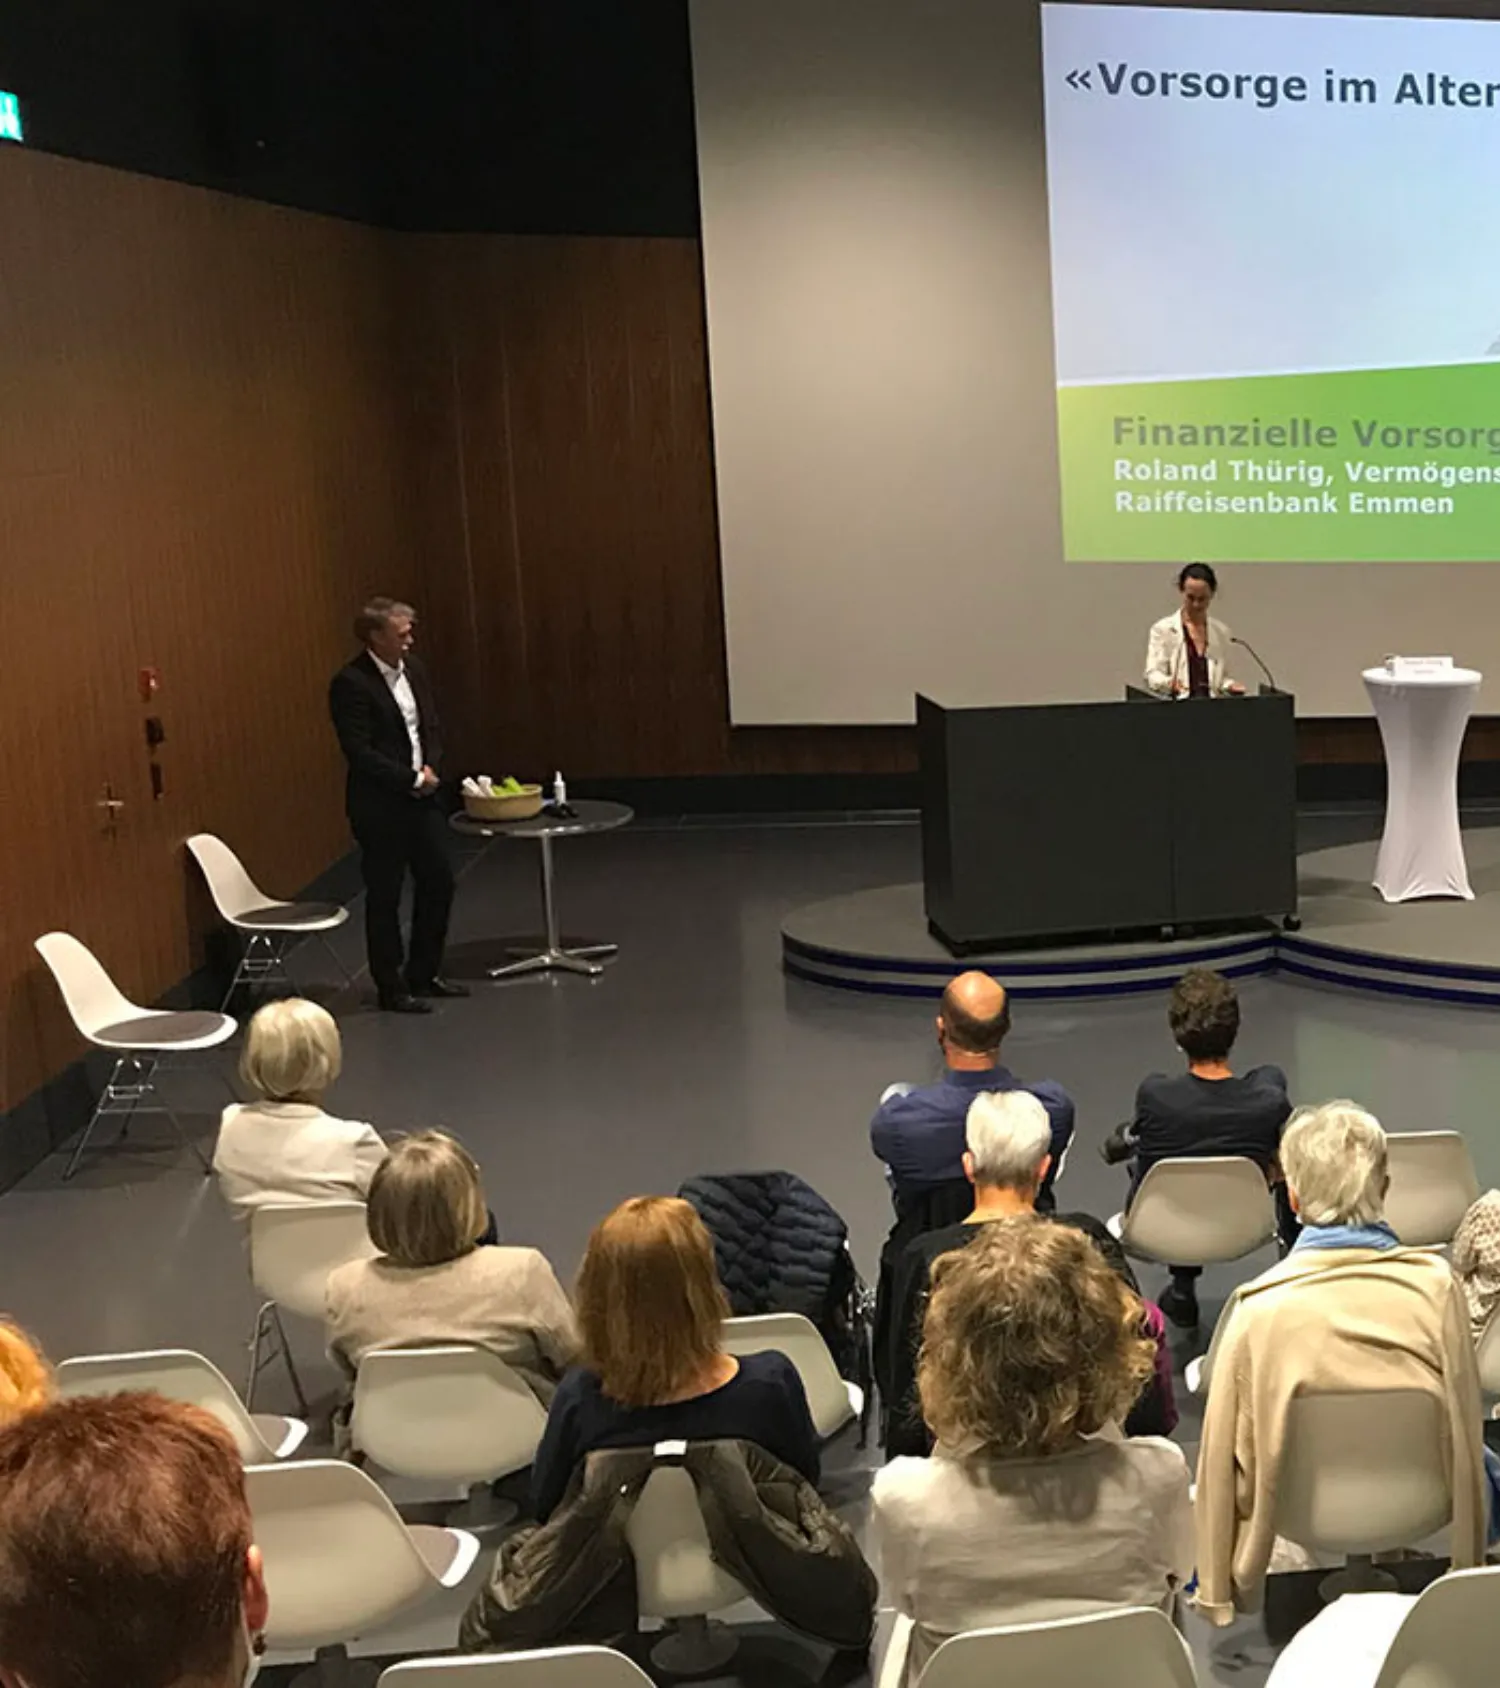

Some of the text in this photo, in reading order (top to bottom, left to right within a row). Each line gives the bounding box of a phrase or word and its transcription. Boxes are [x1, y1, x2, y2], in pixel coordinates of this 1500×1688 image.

[1325, 69, 1377, 104] im
[1113, 416, 1338, 448] Finanzielle
[1113, 459, 1217, 482] Roland
[1228, 459, 1334, 487] Thürig,
[1114, 490, 1455, 514] Raiffeisenbank Emmen
